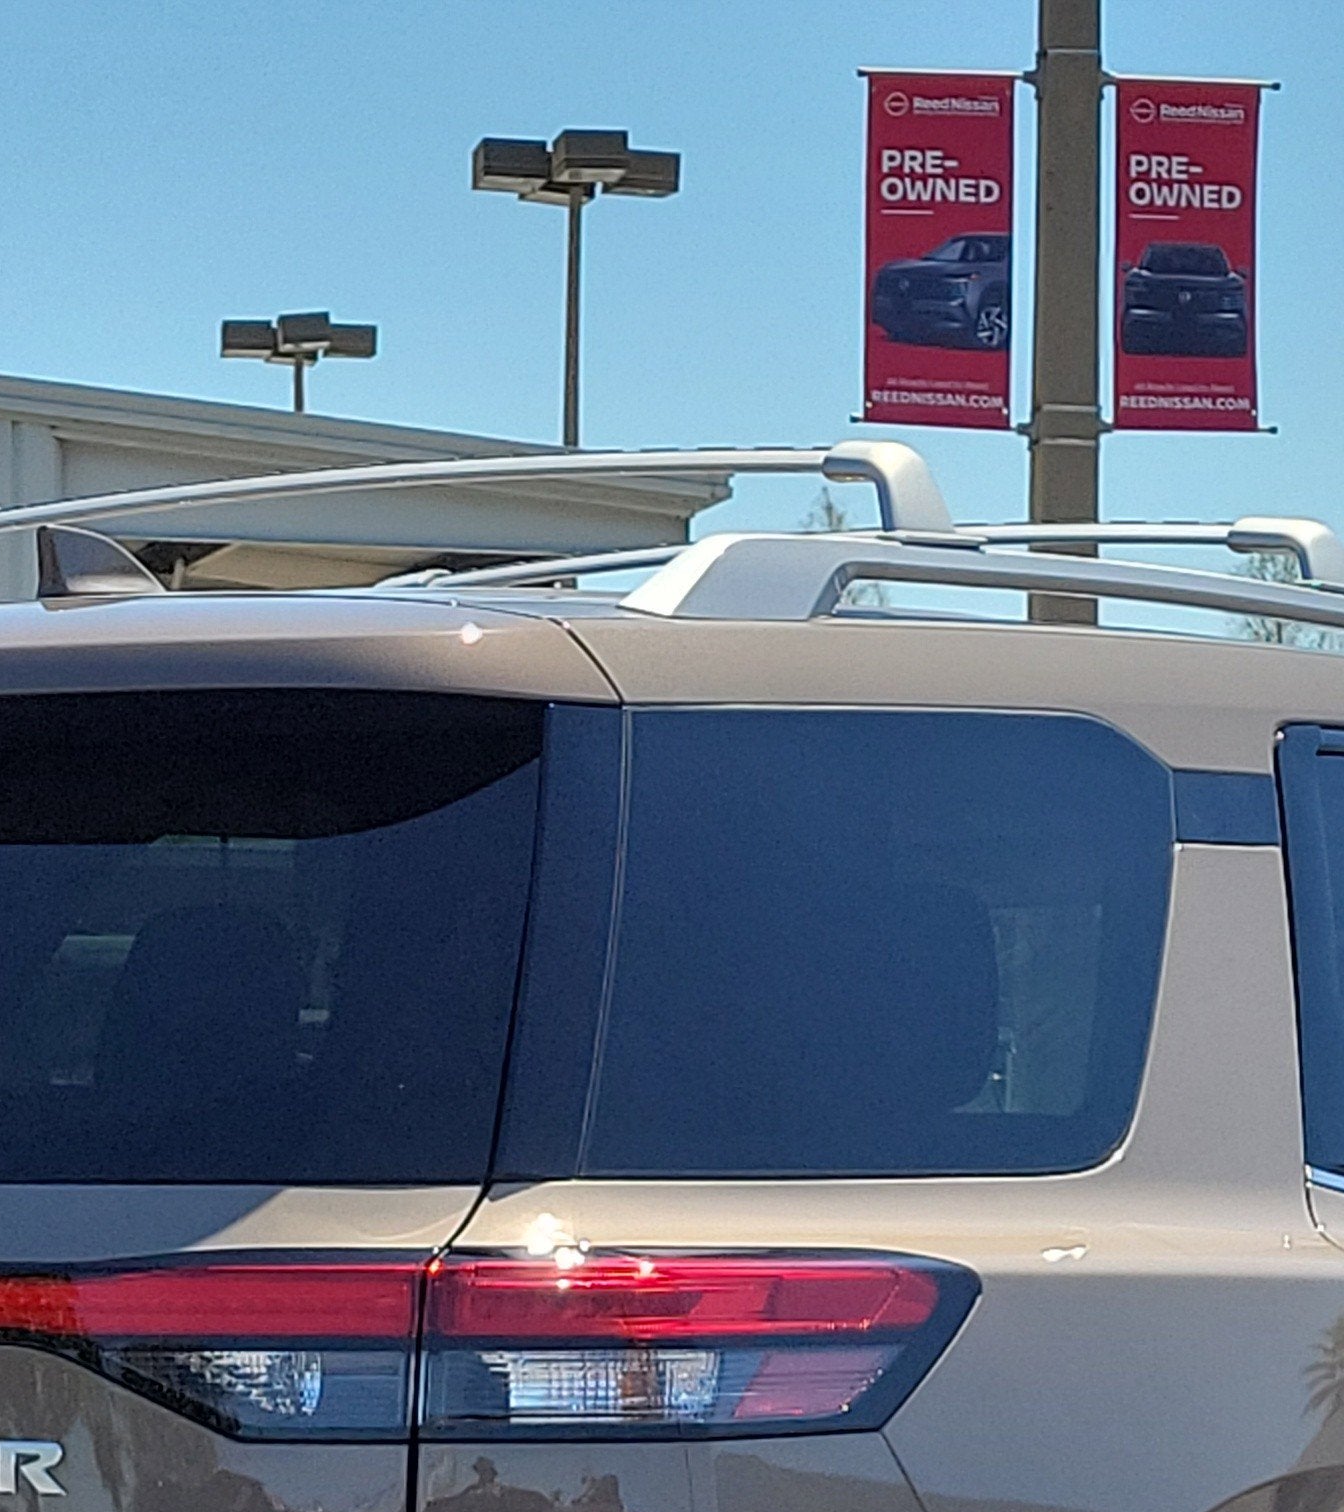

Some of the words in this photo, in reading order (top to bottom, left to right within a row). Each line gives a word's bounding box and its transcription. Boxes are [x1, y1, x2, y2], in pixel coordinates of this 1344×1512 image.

[881, 149, 959, 174] PRE-
[1129, 154, 1204, 180] PRE-
[880, 176, 1001, 203] OWNED
[1128, 181, 1242, 209] OWNED
[870, 389, 1004, 409] REEDNISSAN.COM
[1119, 394, 1251, 411] REEDNISSAN.COM
